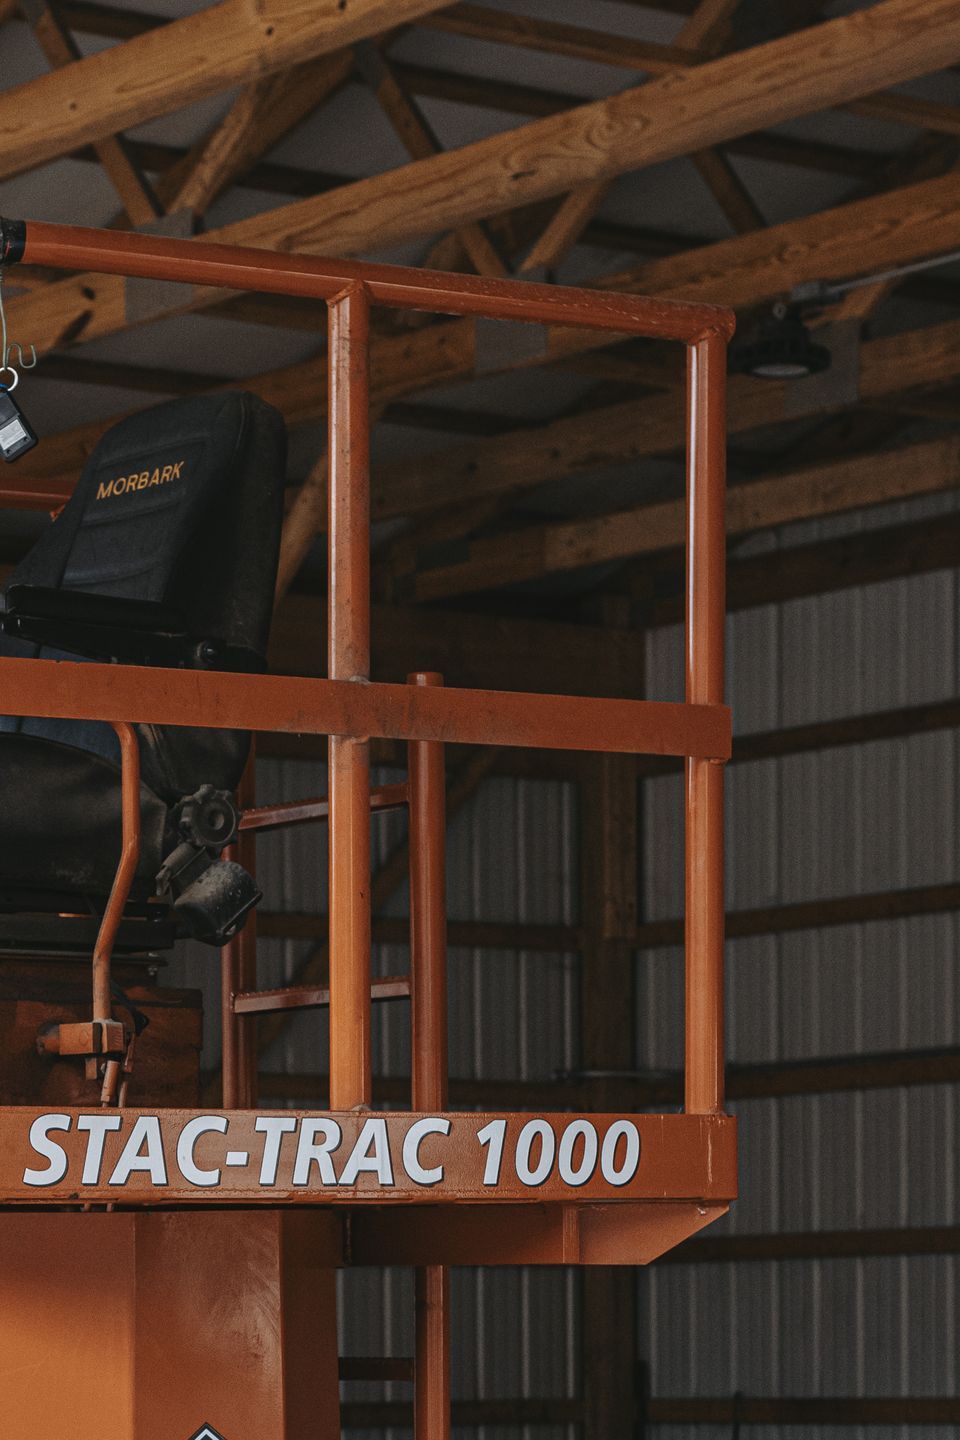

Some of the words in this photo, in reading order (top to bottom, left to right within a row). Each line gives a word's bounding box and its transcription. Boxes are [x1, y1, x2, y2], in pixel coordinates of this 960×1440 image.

[96, 461, 184, 500] MORBARK
[23, 1114, 452, 1186] STAC-TRAC
[477, 1119, 640, 1186] 1000
